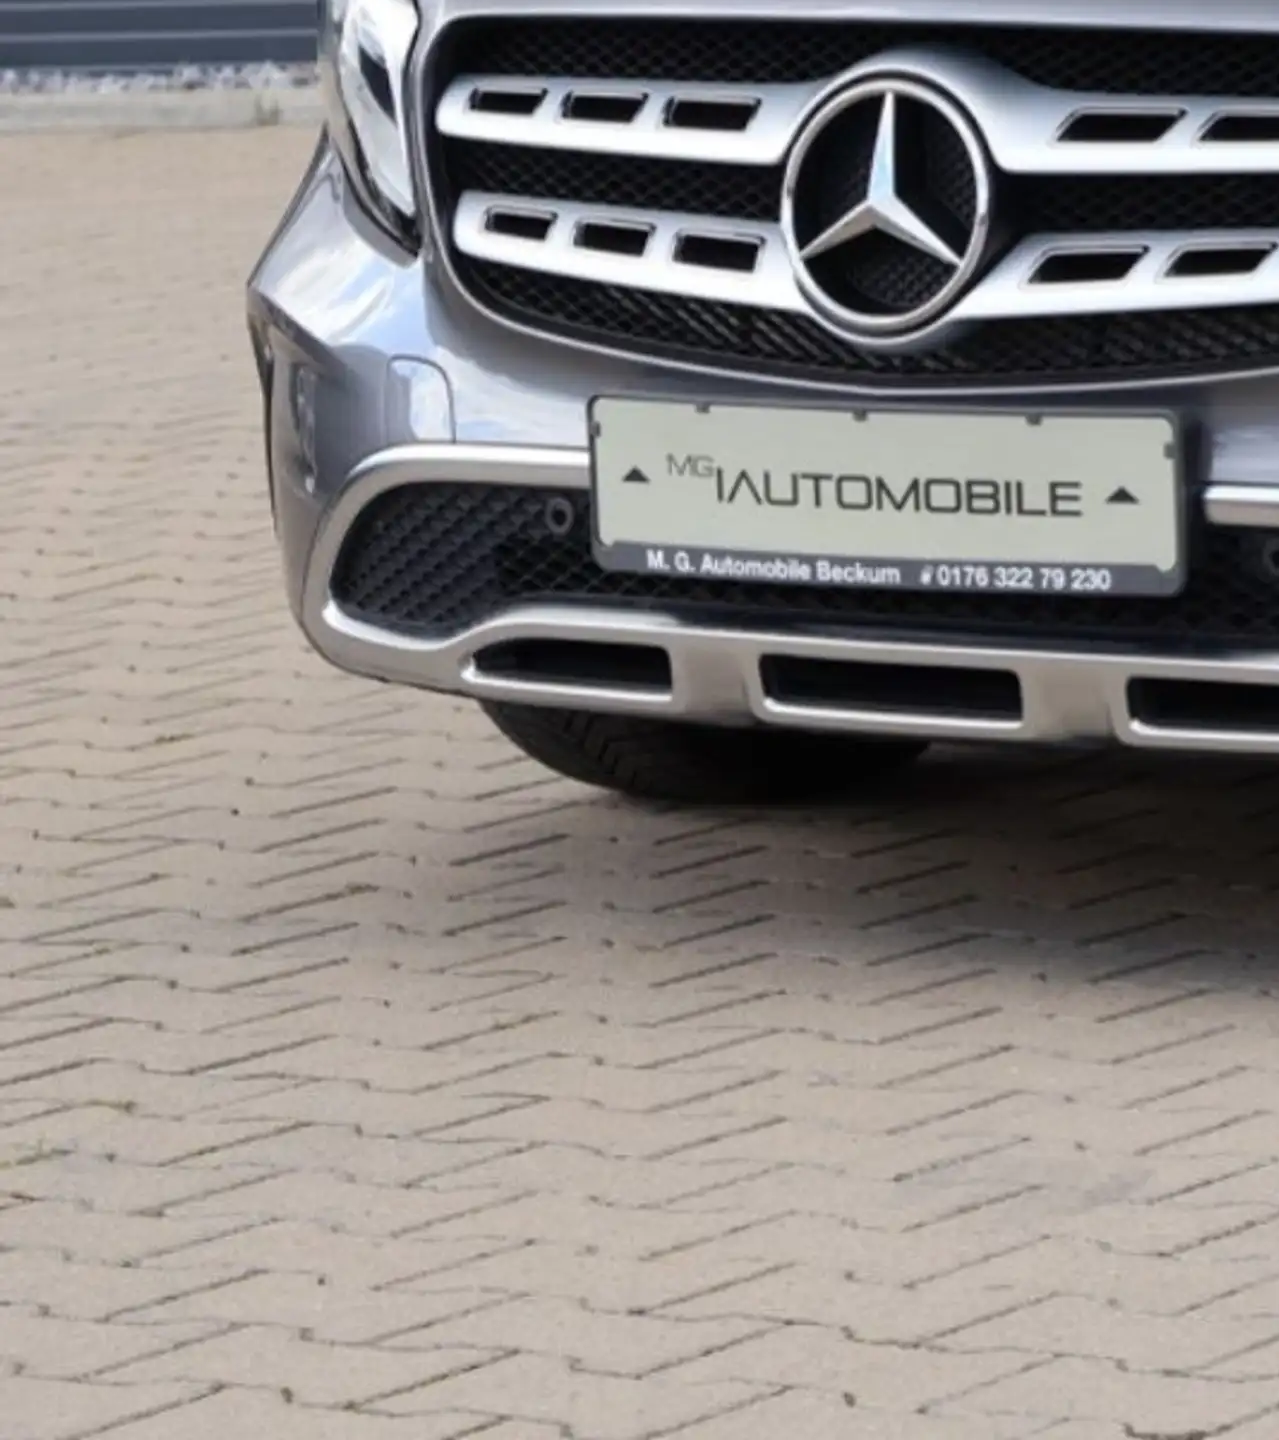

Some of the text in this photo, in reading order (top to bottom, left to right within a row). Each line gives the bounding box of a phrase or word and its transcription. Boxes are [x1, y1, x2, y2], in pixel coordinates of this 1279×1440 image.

[666, 453, 715, 478] MG
[646, 548, 670, 571] M.
[701, 553, 811, 581] Automobile
[816, 559, 900, 585] Beckum
[994, 566, 1034, 589] 322
[1039, 566, 1066, 590] 79
[1071, 567, 1113, 592] 230
